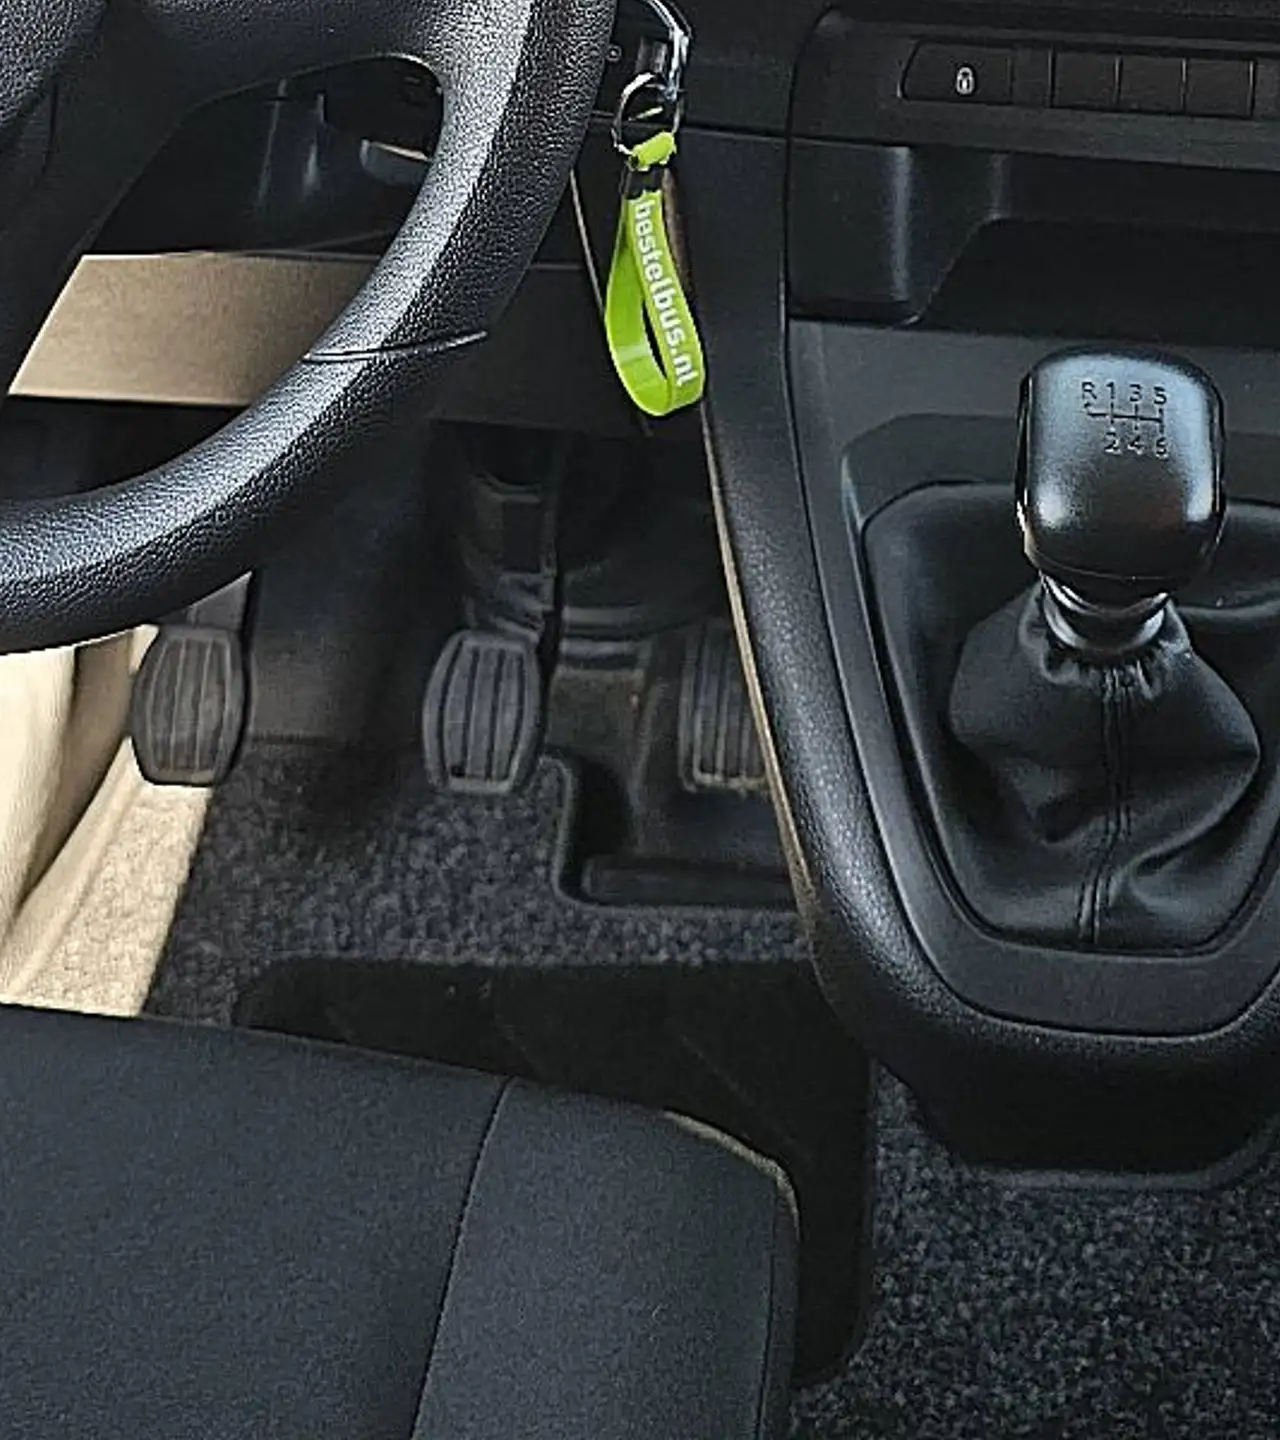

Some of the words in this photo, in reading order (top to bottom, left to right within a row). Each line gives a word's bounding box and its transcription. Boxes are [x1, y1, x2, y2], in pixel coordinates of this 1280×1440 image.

[632, 197, 699, 387] bestelbus.nl
[1081, 380, 1098, 400] R
[1105, 381, 1116, 400] 1
[1128, 383, 1143, 403] 3
